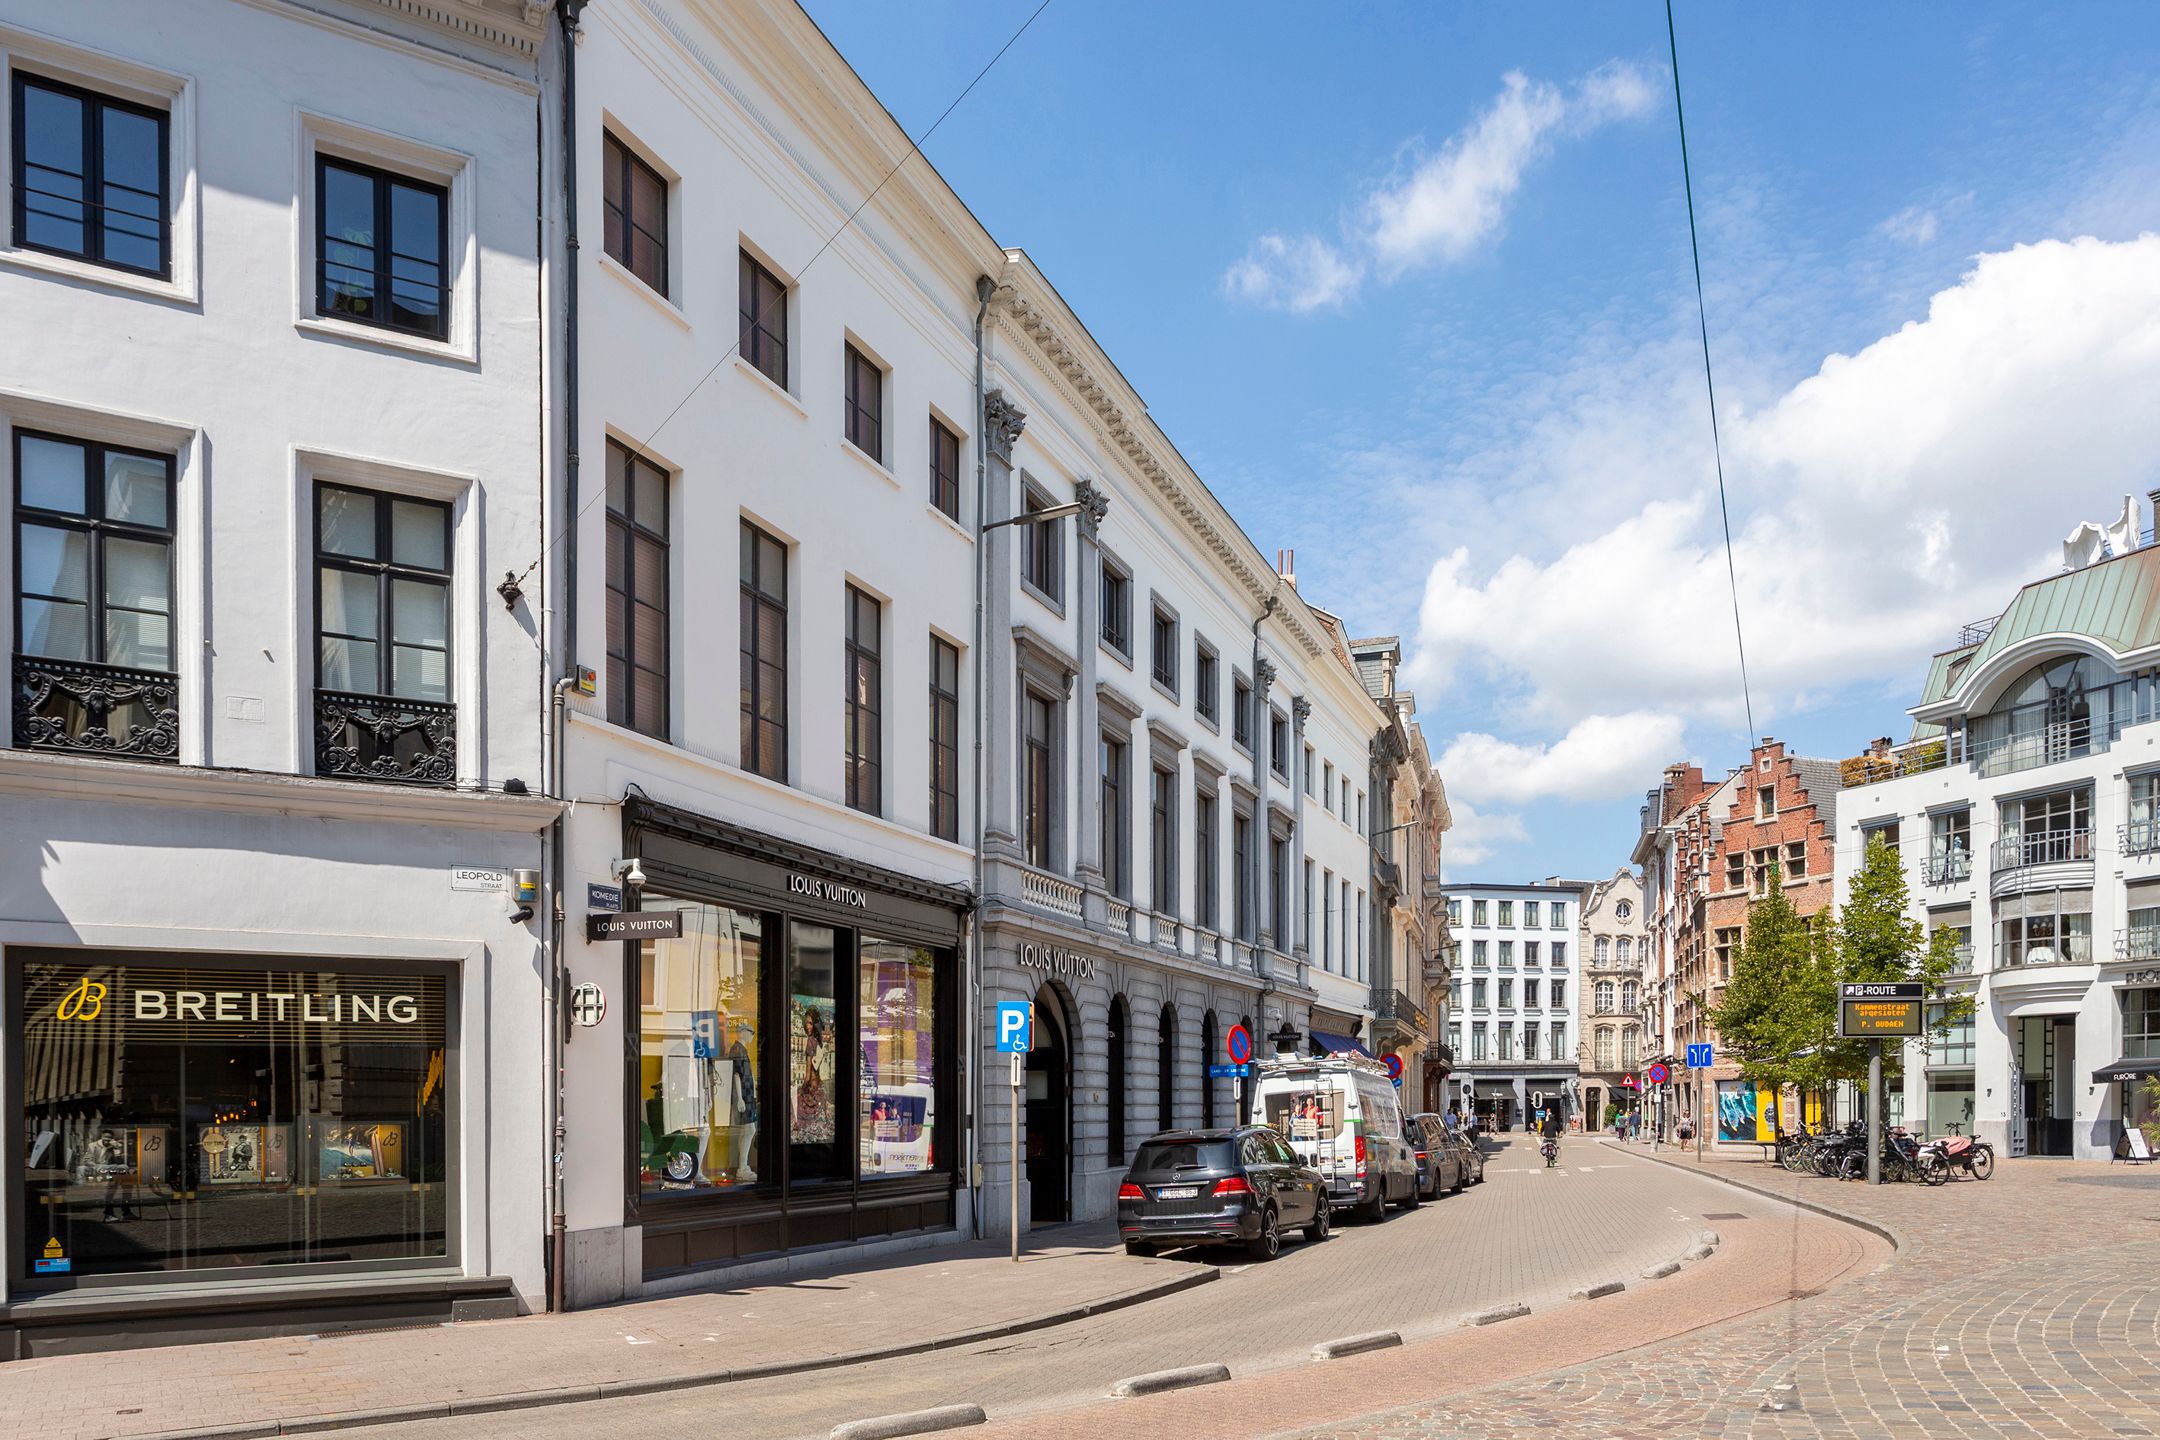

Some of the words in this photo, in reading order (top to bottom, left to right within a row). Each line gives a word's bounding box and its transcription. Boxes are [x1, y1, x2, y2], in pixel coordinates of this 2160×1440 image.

[456, 871, 503, 881] LEOPOLD
[591, 890, 619, 902] KOMEDIE
[790, 874, 822, 897] LOUIS
[824, 882, 866, 908] VUITTON
[597, 921, 625, 932] LOUIS
[629, 919, 673, 930] VUITTON
[1020, 943, 1051, 970] LOUIS
[1053, 950, 1095, 980] VUITTON
[134, 990, 418, 1024] BREITLING
[1855, 1003, 1910, 1011] Kammenstraat
[1001, 1009, 1025, 1043] P
[1875, 1020, 1904, 1028] OUDAEN
[2113, 1072, 2137, 1081] FURORE
